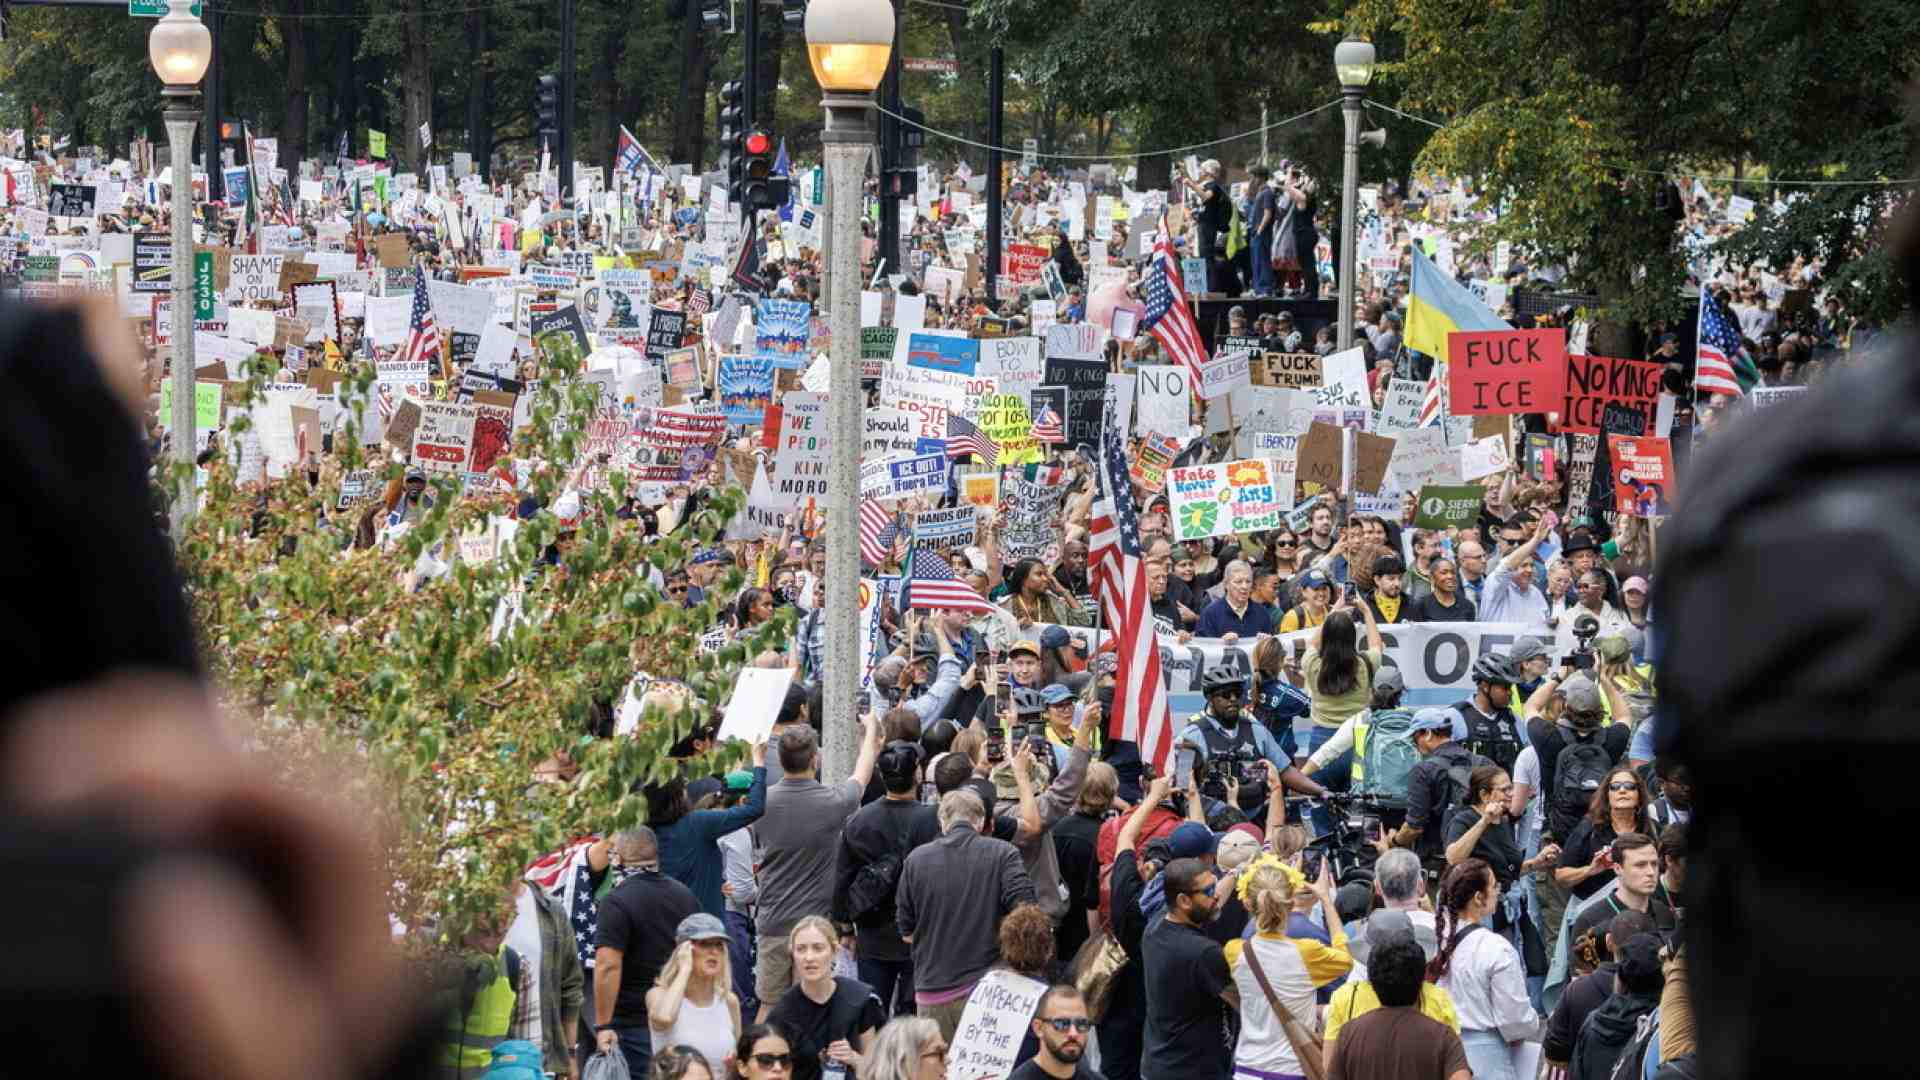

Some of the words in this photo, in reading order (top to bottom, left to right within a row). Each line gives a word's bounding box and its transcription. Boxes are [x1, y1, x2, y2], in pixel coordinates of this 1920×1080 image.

[232, 257, 283, 274] SHAME
[247, 275, 263, 284] ON
[240, 286, 275, 299] YOU!
[194, 322, 228, 331] GUILTY
[863, 334, 894, 345] CAGO
[996, 341, 1029, 357] BOW
[1466, 338, 1543, 368] FUCK
[411, 362, 427, 371] OFF
[1266, 355, 1315, 371] FUCK
[1049, 367, 1066, 382] NO
[1073, 367, 1104, 382] KINGS
[1271, 371, 1321, 385] TRUMP
[1141, 369, 1183, 397] NO
[1472, 380, 1532, 410] ICE
[425, 405, 443, 415] THEY
[897, 401, 946, 427] EPSTE
[1562, 397, 1601, 427] ICE
[866, 417, 911, 434] Should
[920, 426, 942, 439] ES
[640, 429, 673, 446] MAGA
[788, 435, 831, 450] PEOP
[1255, 434, 1297, 450] LIBERTY
[898, 460, 916, 474] ICE
[1271, 459, 1294, 473] TICE
[1311, 463, 1333, 479] NO
[1571, 462, 1594, 473] ANT
[1172, 466, 1217, 483] Hate
[779, 479, 829, 494] MORO
[1175, 479, 1217, 496] Never
[1238, 485, 1273, 504] Any
[1447, 498, 1481, 509] SIERRA
[748, 505, 785, 529] KING
[917, 510, 955, 525] HANDS
[955, 506, 974, 521] OFF
[1231, 514, 1280, 530] Great
[916, 532, 973, 552] CHICAGO
[970, 984, 1035, 1015] IMPEACH
[980, 1012, 998, 1030] HIM
[964, 1023, 981, 1042] BY
[985, 1030, 1011, 1049] THE
